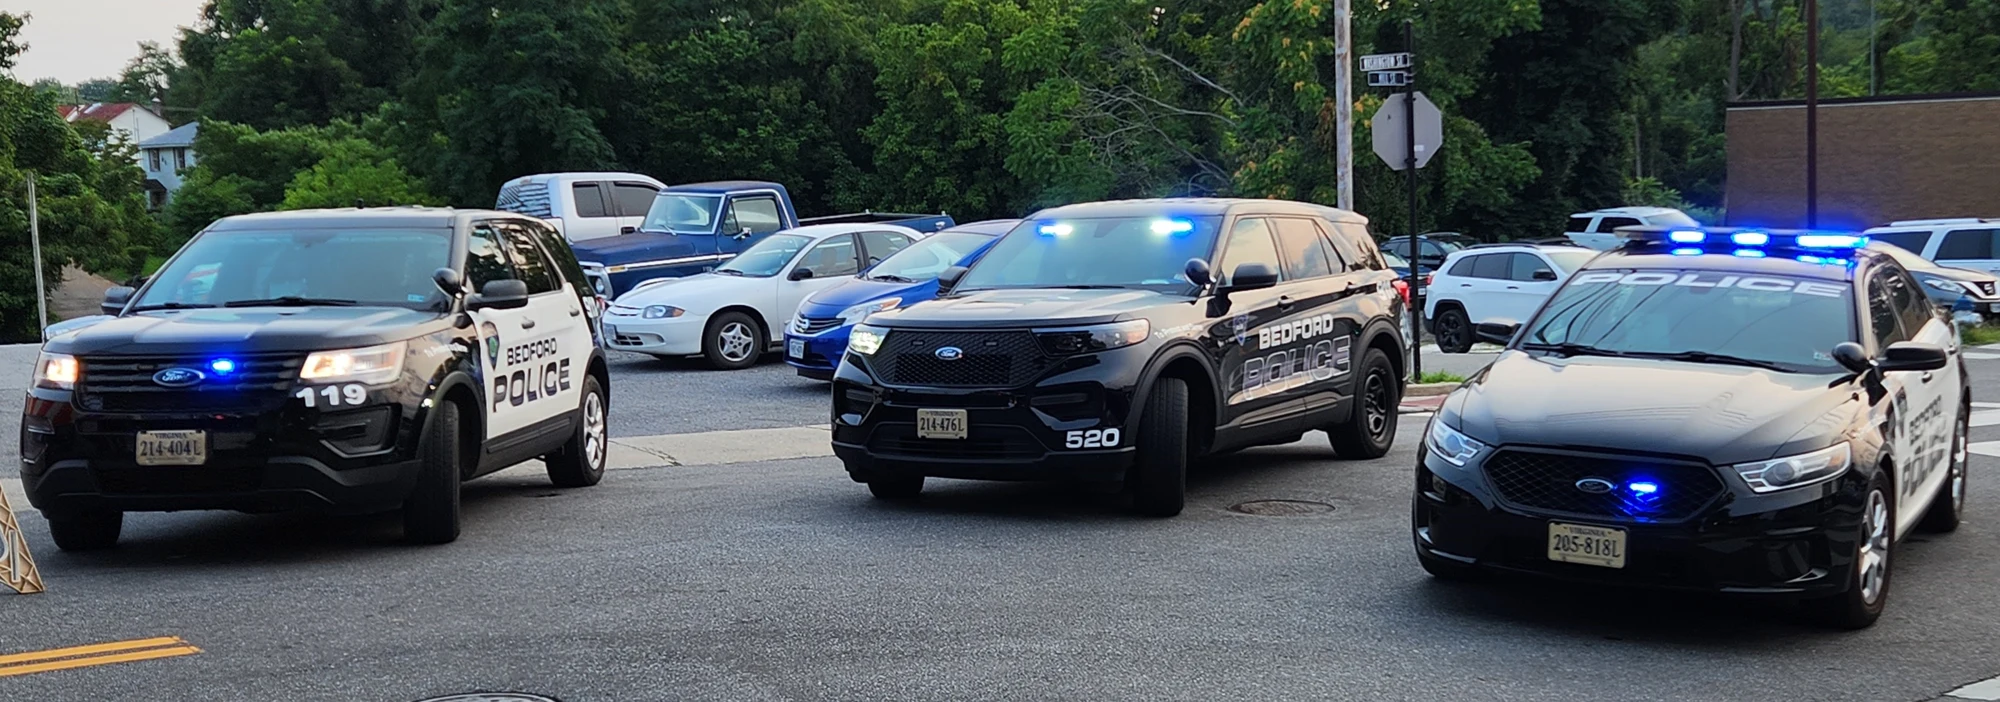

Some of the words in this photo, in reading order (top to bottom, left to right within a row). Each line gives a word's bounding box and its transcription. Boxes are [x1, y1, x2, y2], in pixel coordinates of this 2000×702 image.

[1571, 272, 1847, 297] POLICE
[1259, 313, 1334, 349] BEDFORD
[507, 337, 557, 366] BEDFORD
[1242, 335, 1351, 401] POLICE
[296, 384, 367, 408] 119
[493, 357, 570, 413] POLICE
[919, 416, 965, 433] 214-476L
[139, 438, 202, 457] 214-404L
[1065, 428, 1120, 449] 520
[1570, 526, 1606, 537] VIRGINIA
[1553, 534, 1621, 558] 205-818L
